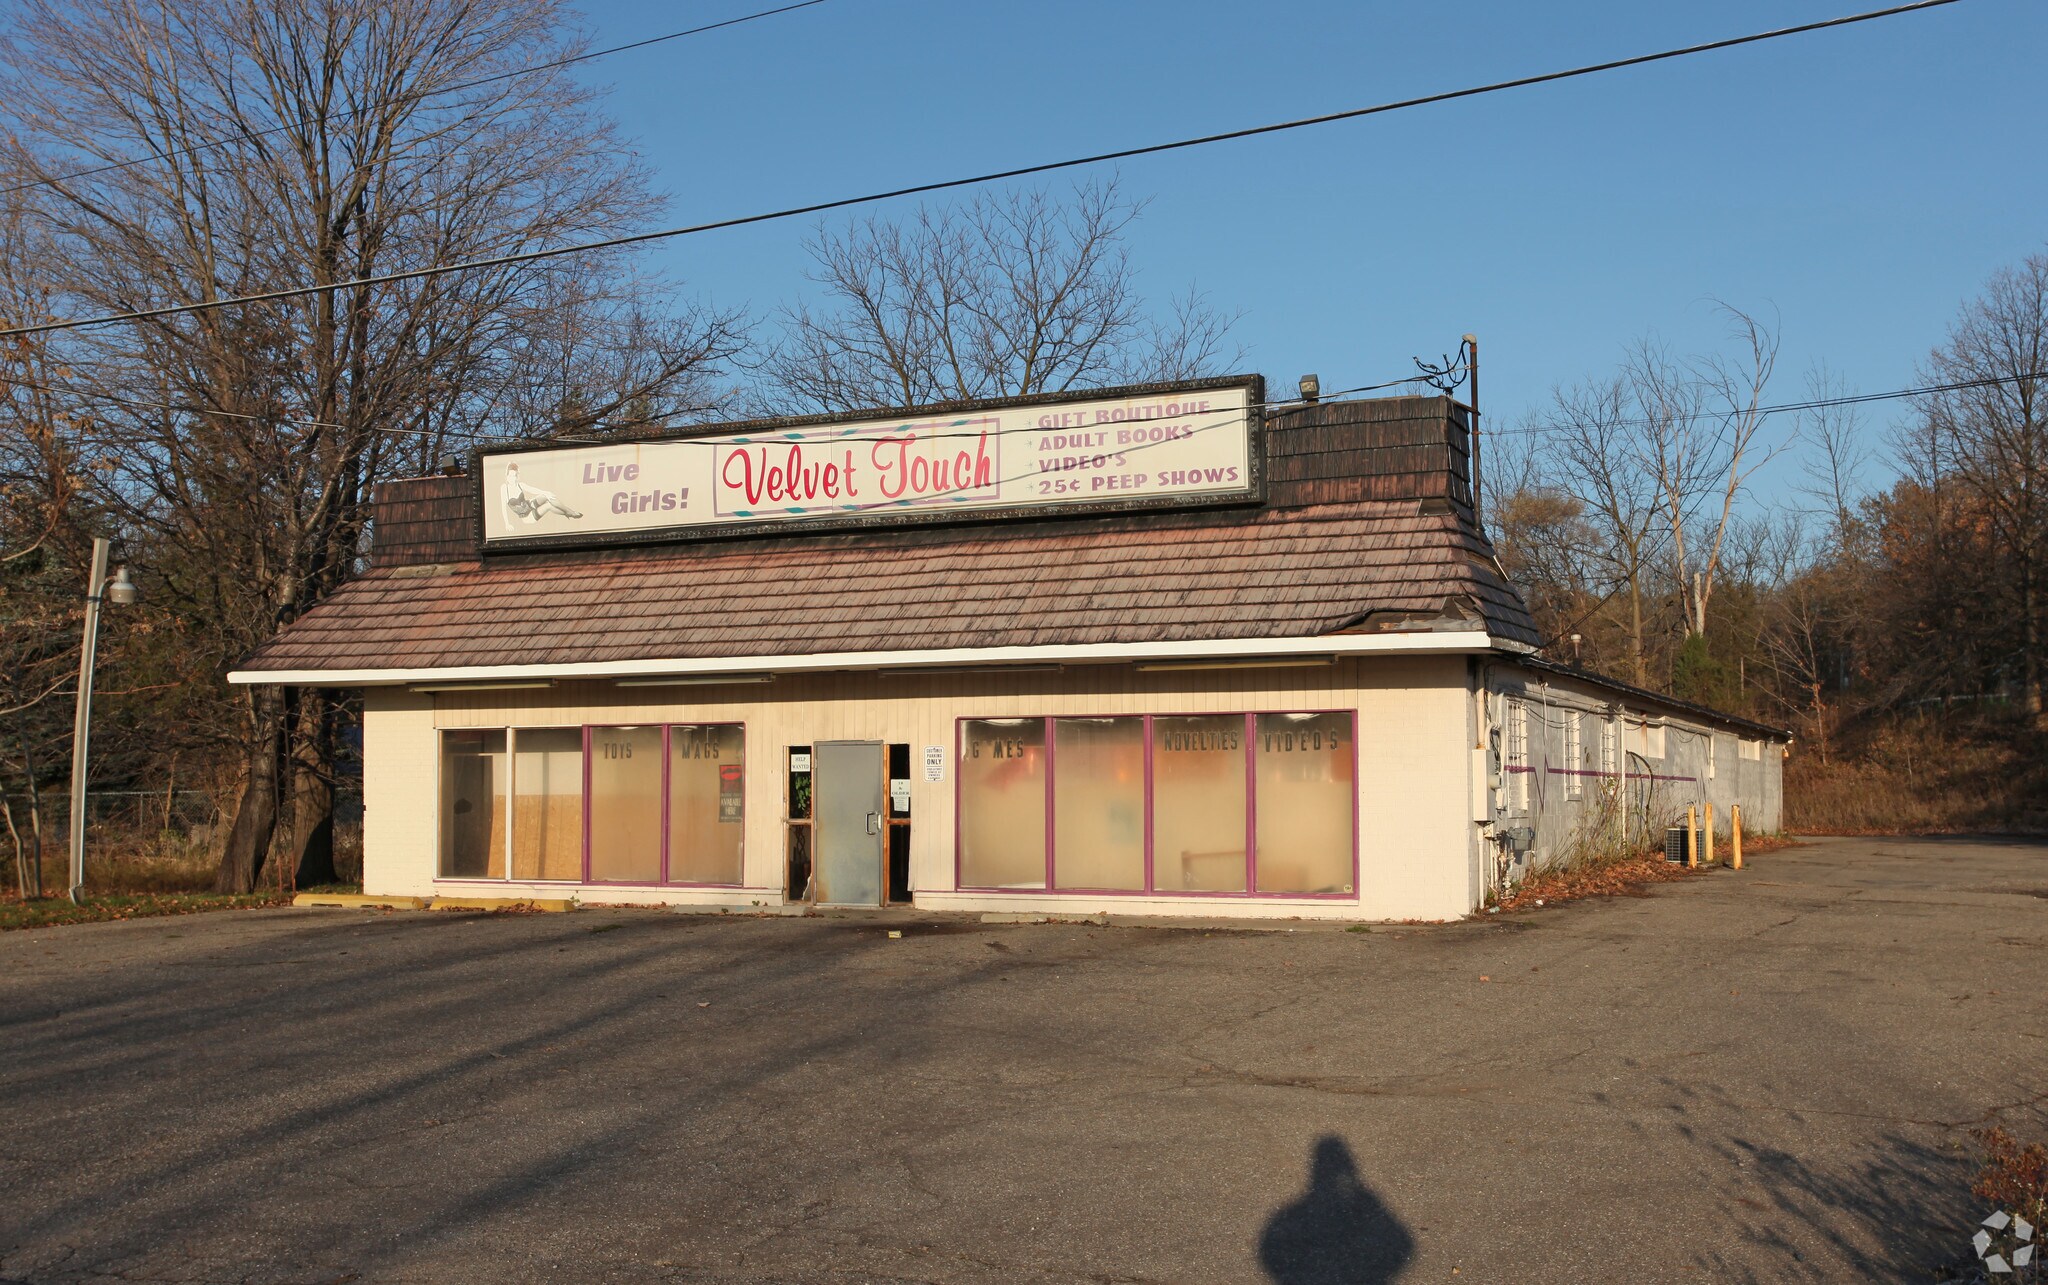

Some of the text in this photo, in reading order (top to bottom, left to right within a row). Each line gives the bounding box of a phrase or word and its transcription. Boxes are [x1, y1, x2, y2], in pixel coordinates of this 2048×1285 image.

[1038, 401, 1211, 429] GIFT BOUTIQUE
[1039, 424, 1193, 451] ADULT BOOKS
[583, 462, 640, 484] Live
[723, 430, 991, 505] Velvet Touch
[1039, 452, 1127, 473] VIDEO'S
[1038, 466, 1239, 495] 25¢ PEEP SHOWS
[611, 487, 689, 514] Girls!
[604, 742, 632, 759] TOYS
[681, 742, 719, 759] MAGS
[972, 740, 1024, 758] GMES
[1164, 730, 1238, 751] NOVELTIES
[1265, 731, 1338, 752] VIDEOS
